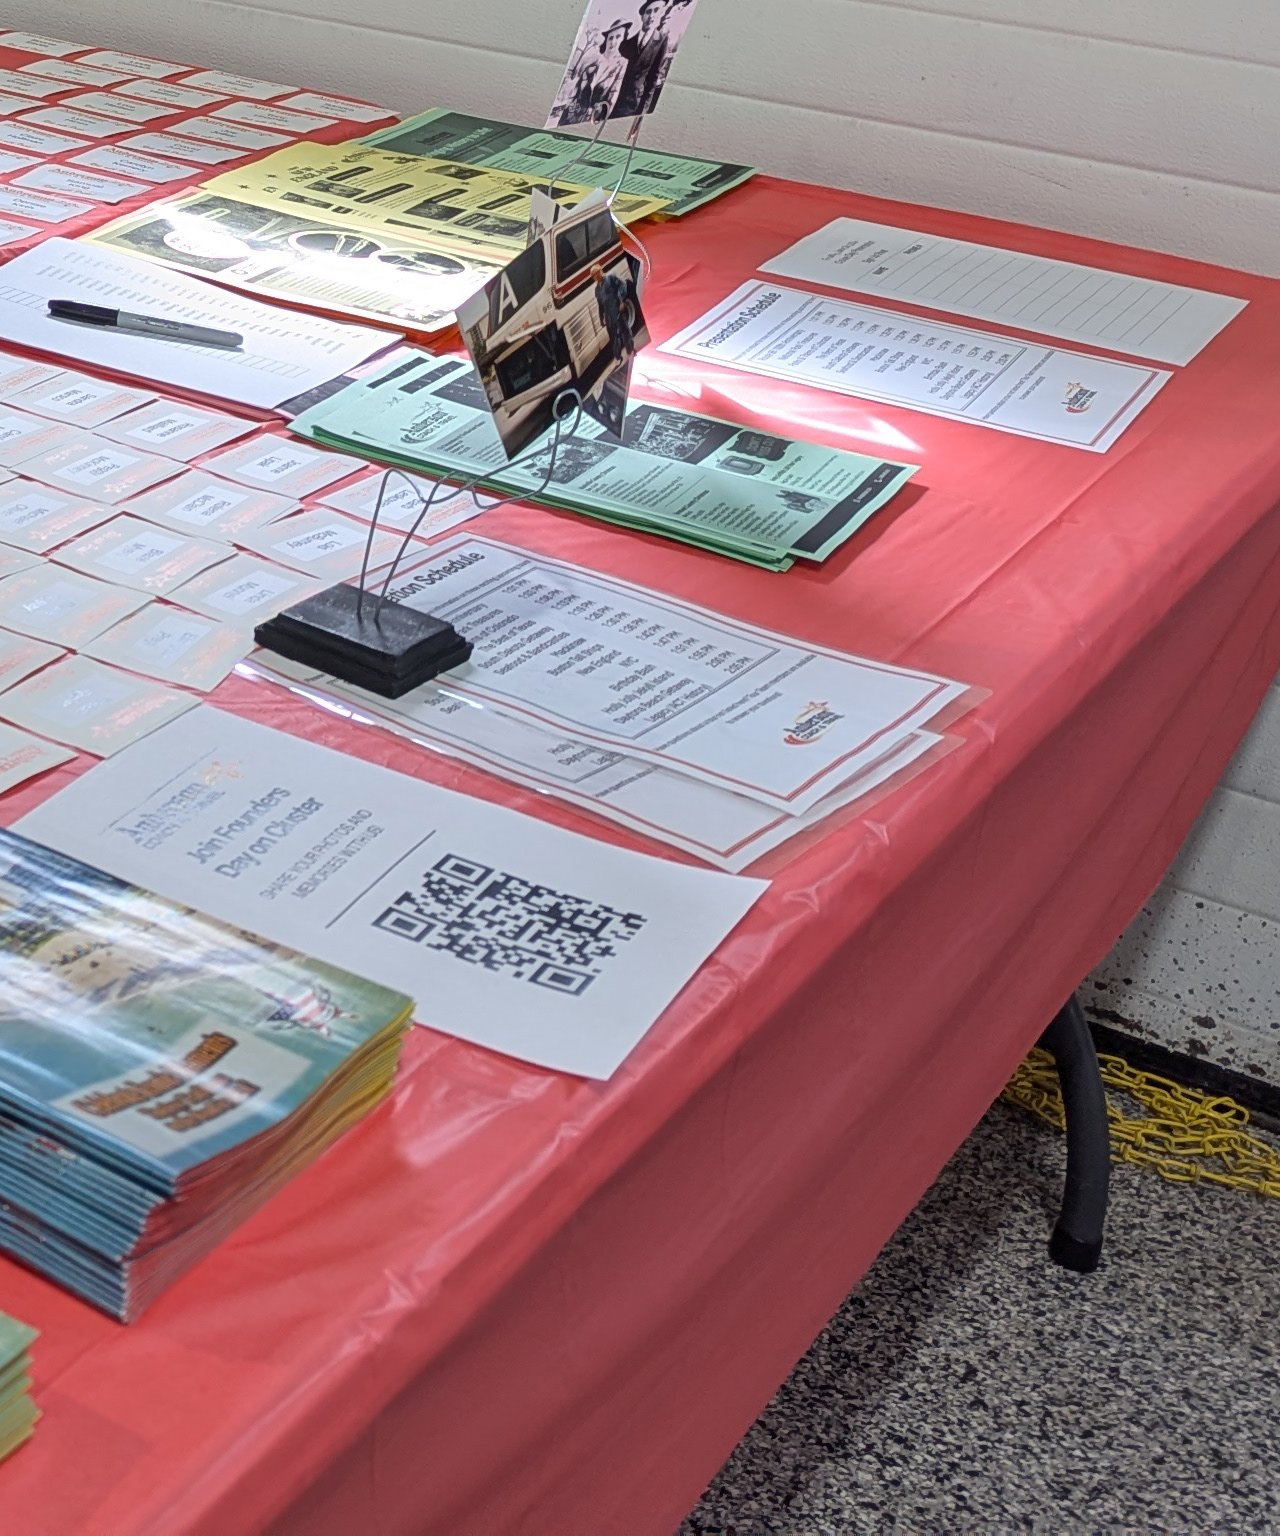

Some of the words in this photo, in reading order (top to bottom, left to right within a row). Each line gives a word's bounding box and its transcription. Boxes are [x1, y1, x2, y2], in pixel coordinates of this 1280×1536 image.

[498, 272, 518, 324] A
[697, 313, 752, 349] Presentation
[739, 292, 782, 320] Schedule
[414, 550, 485, 585] Schedule
[665, 630, 682, 641] PM
[683, 637, 700, 646] PM
[701, 644, 718, 653] PM
[546, 660, 575, 676] Boston
[576, 666, 597, 676] New
[590, 649, 622, 667] England
[718, 650, 735, 660] PM
[737, 656, 754, 667] PM
[187, 832, 224, 865] Join
[216, 786, 291, 840] Founders
[214, 846, 255, 879] Day
[249, 834, 276, 865] on
[264, 795, 324, 837] Cluster
[258, 869, 292, 900] SHARE
[291, 849, 319, 875] YOUR
[311, 822, 348, 856] PHOTOS
[344, 807, 373, 832] AND
